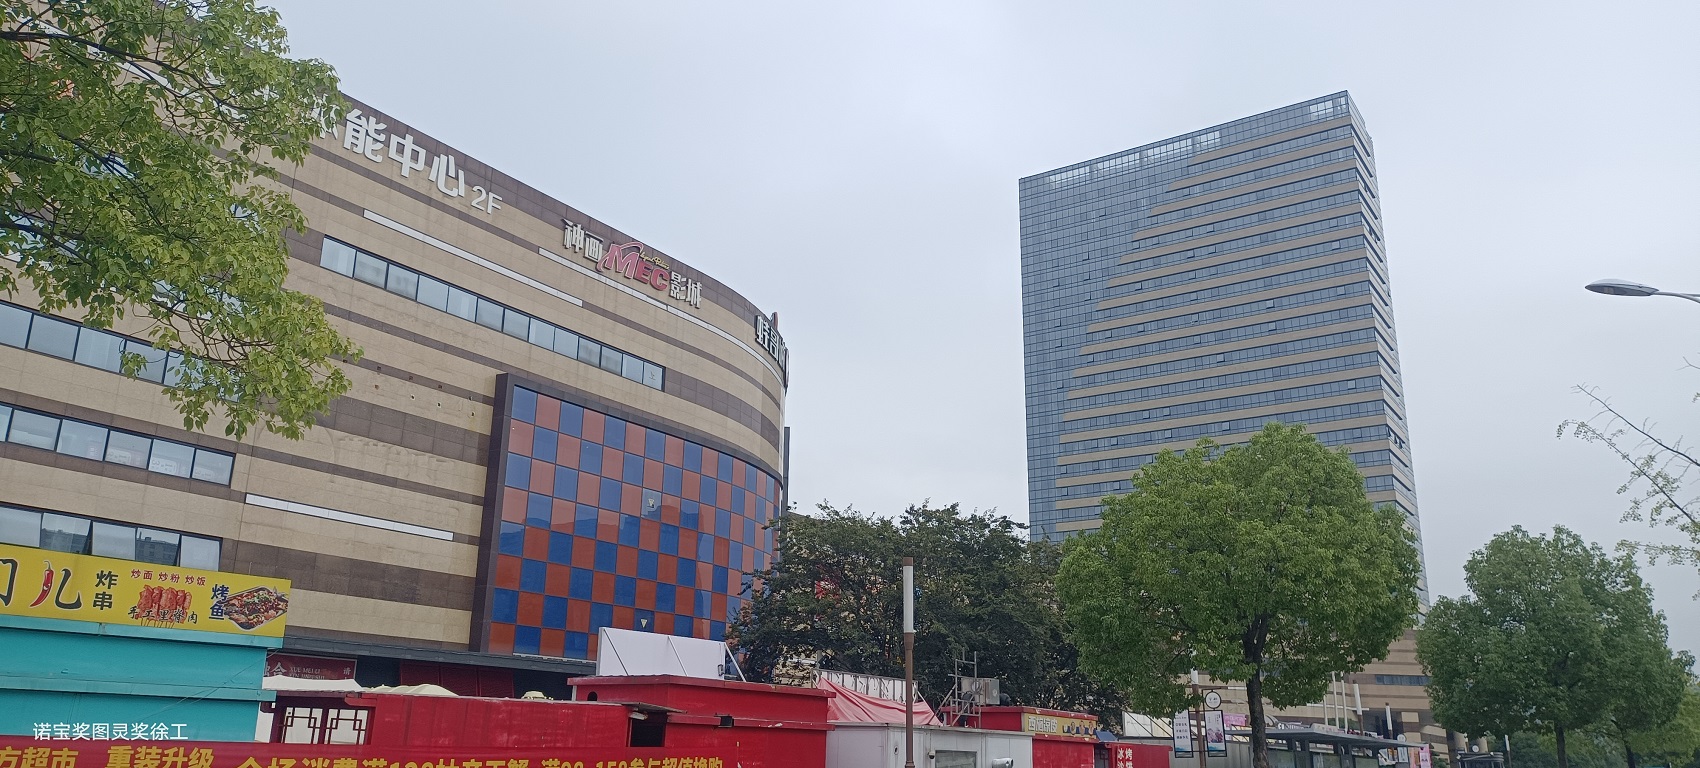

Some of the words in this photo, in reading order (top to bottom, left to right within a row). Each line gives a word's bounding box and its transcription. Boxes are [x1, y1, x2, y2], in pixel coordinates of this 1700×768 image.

[471, 186, 502, 214] 2F
[562, 218, 603, 262] 神画
[597, 241, 669, 291] MEC
[670, 271, 702, 309] 影城
[93, 570, 118, 611] 炸串
[131, 569, 153, 580] 炒面
[158, 572, 180, 584] 炒粉
[185, 575, 206, 586] 炒饭
[128, 607, 198, 623] 手工里脊肉
[209, 583, 230, 620] 烤鱼
[106, 745, 214, 768] 重装升级
